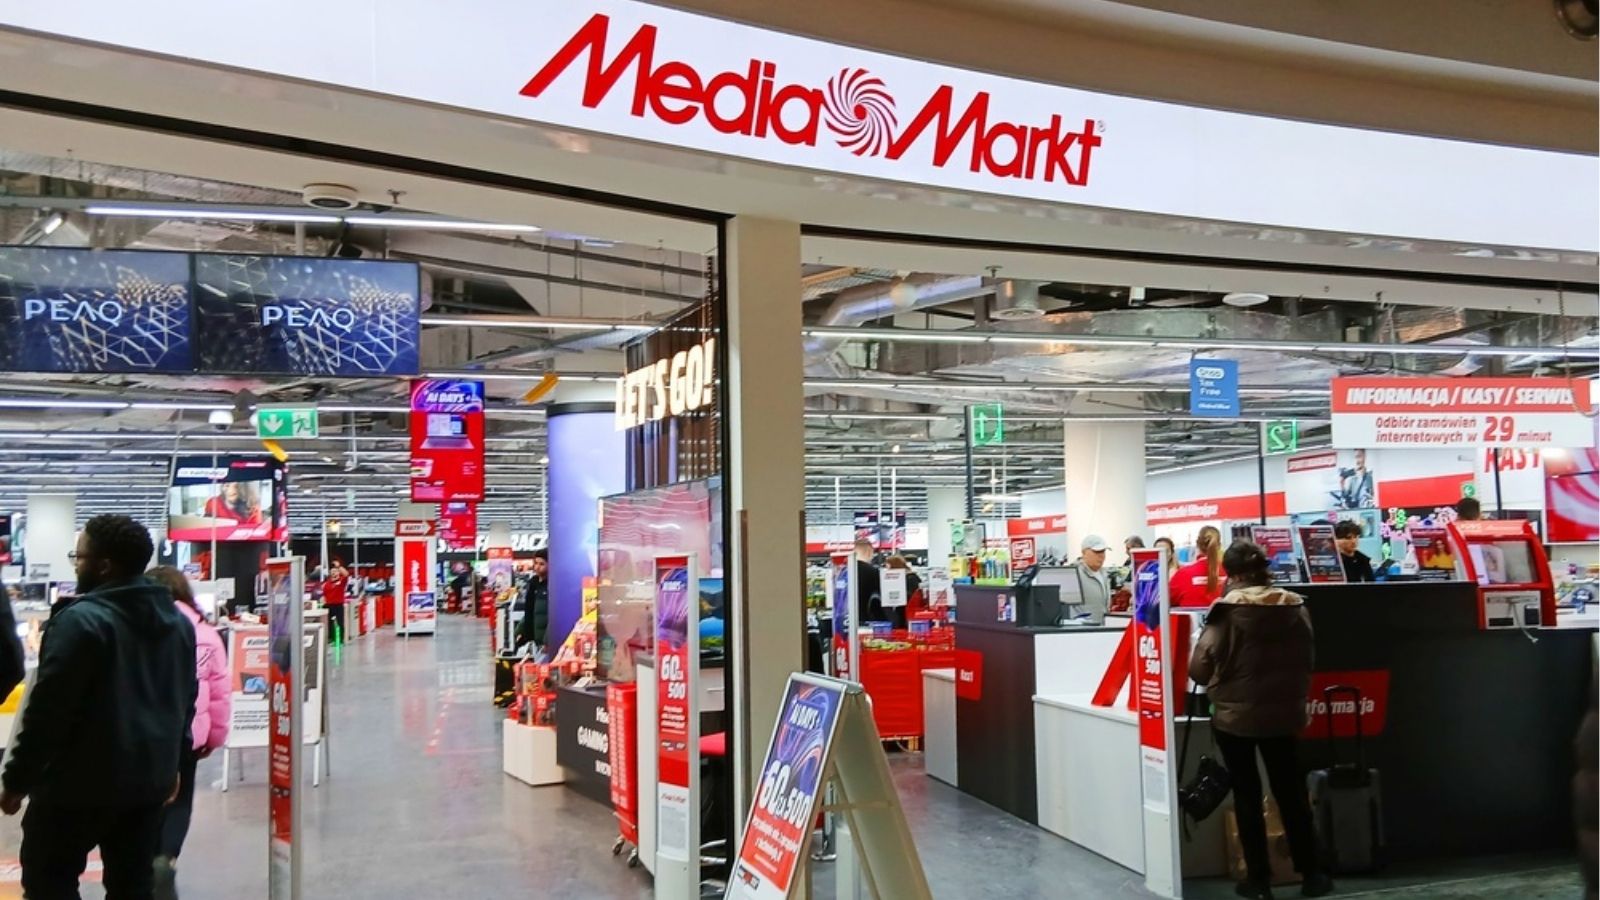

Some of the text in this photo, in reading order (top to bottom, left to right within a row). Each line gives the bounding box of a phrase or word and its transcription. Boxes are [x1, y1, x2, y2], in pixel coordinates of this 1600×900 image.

[519, 13, 1103, 187] Media Markt
[615, 338, 715, 432] LET'S GO!
[1346, 387, 1450, 407] INFORMACJA
[1461, 387, 1502, 405] KASY
[1375, 416, 1477, 428] Odbiór zamówień
[1375, 416, 1552, 443] internetowych w 29 minut
[577, 725, 608, 754] GAMING
[784, 787, 814, 829] 500
